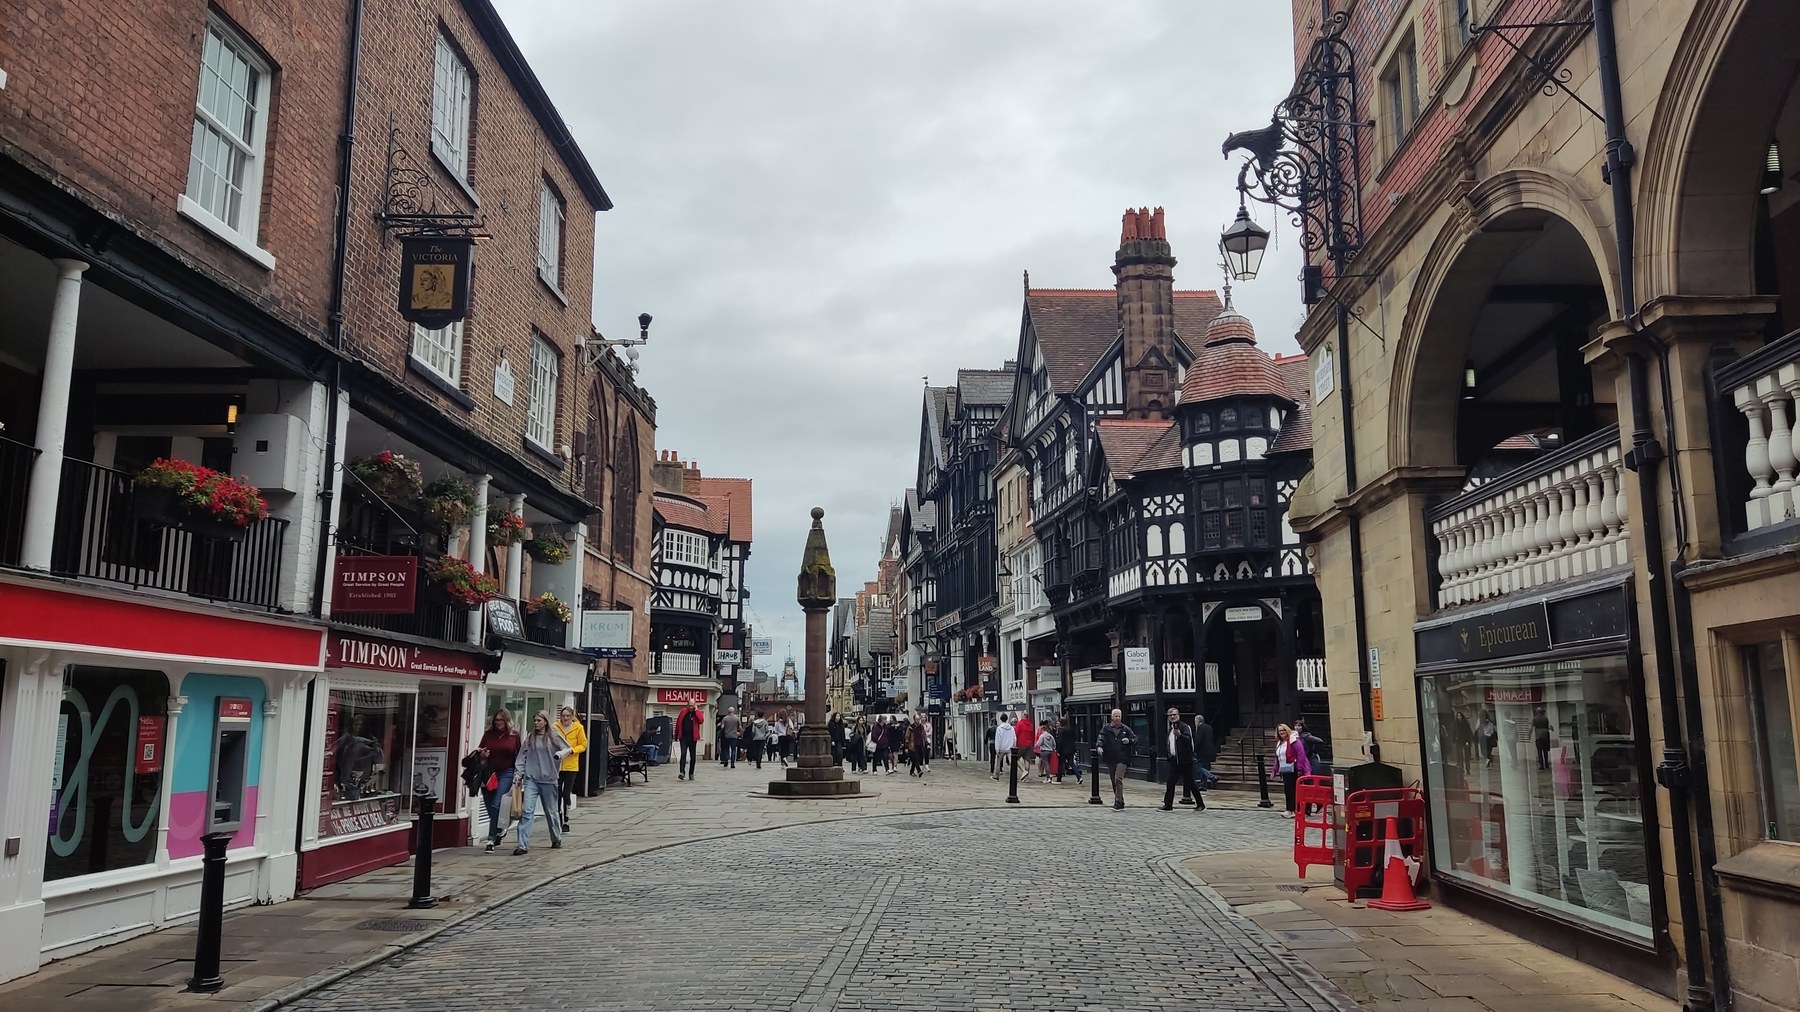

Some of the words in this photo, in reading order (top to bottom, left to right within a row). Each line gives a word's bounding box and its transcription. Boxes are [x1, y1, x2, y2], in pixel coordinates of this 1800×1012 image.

[430, 245, 442, 253] The
[412, 253, 458, 261] VICTORIA
[342, 572, 407, 582] TIMPSON
[497, 617, 514, 634] FOOD
[590, 622, 624, 631] KRUM
[1478, 621, 1539, 653] Epicurean
[340, 638, 408, 669] TIMPSON
[717, 651, 739, 661] SHRUB
[1126, 650, 1148, 658] Gabor
[410, 662, 423, 670] Great
[422, 663, 438, 672] Service
[438, 664, 444, 673] By
[444, 665, 454, 674] Great
[454, 665, 467, 675] People
[414, 755, 439, 763] ngraving
[330, 808, 341, 820] ASK
[340, 816, 362, 833] PRICE
[358, 813, 372, 830] KEY
[370, 811, 387, 827] DEAL
